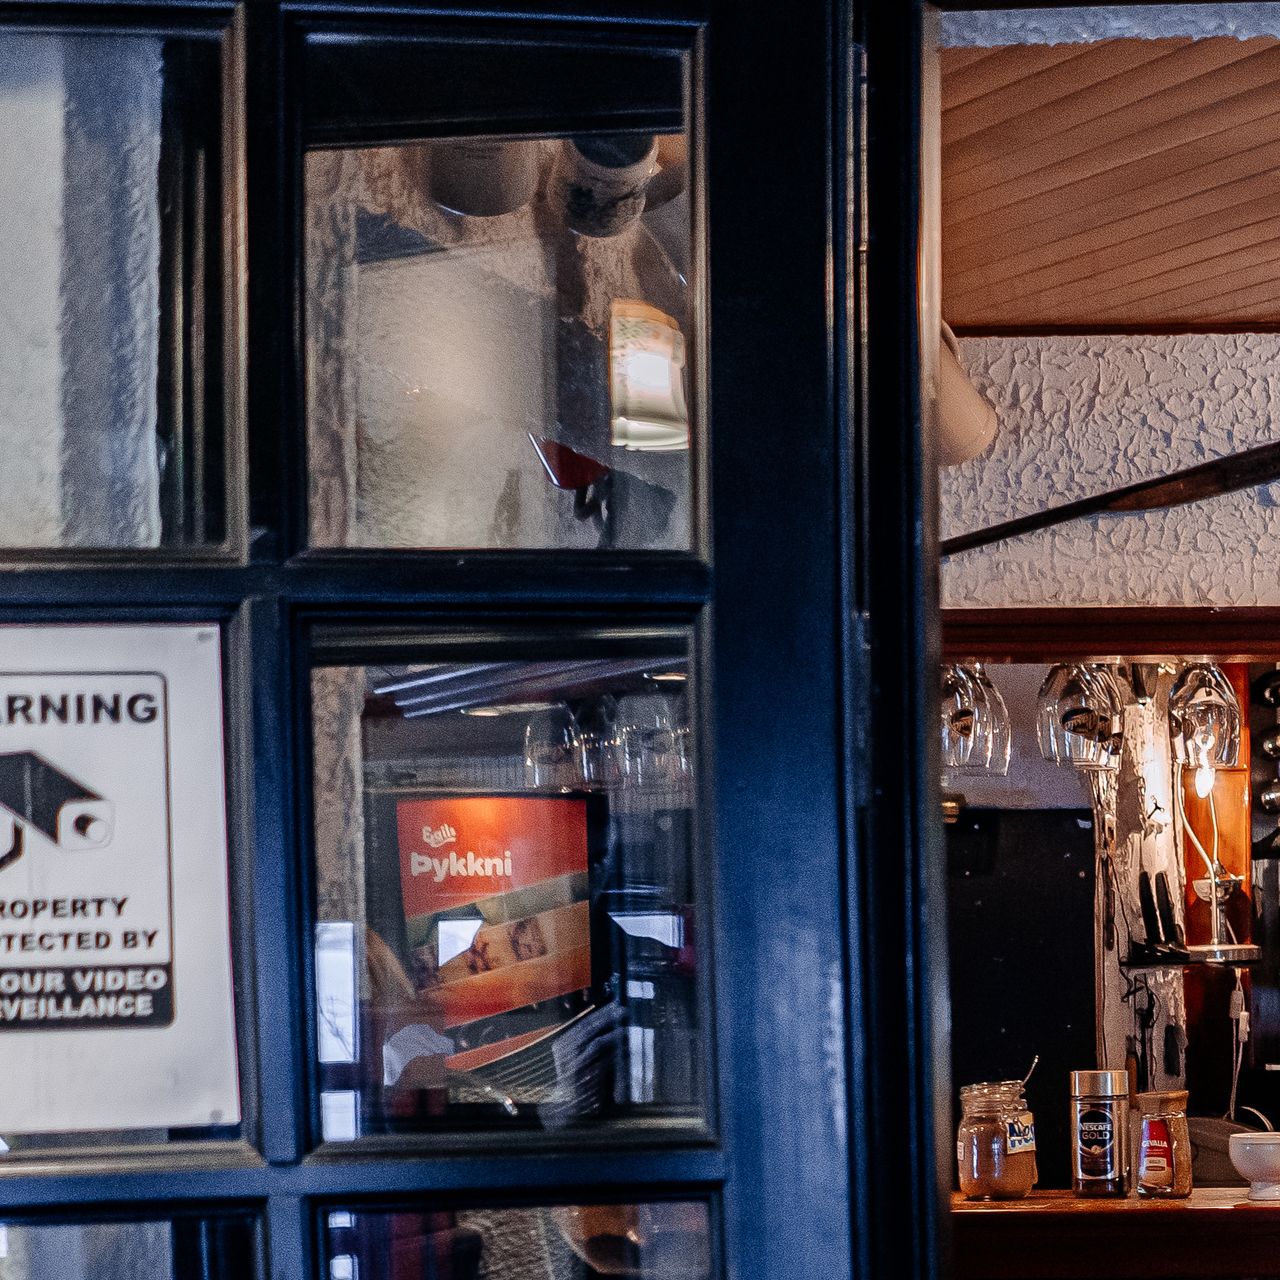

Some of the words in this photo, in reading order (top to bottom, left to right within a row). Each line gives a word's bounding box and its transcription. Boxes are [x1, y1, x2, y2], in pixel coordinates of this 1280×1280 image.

[0, 693, 158, 724] RNING
[122, 929, 158, 949] BY
[71, 968, 168, 993] VIDEO
[0, 994, 153, 1021] VEILLANCE
[1082, 1131, 1110, 1139] GOLD
